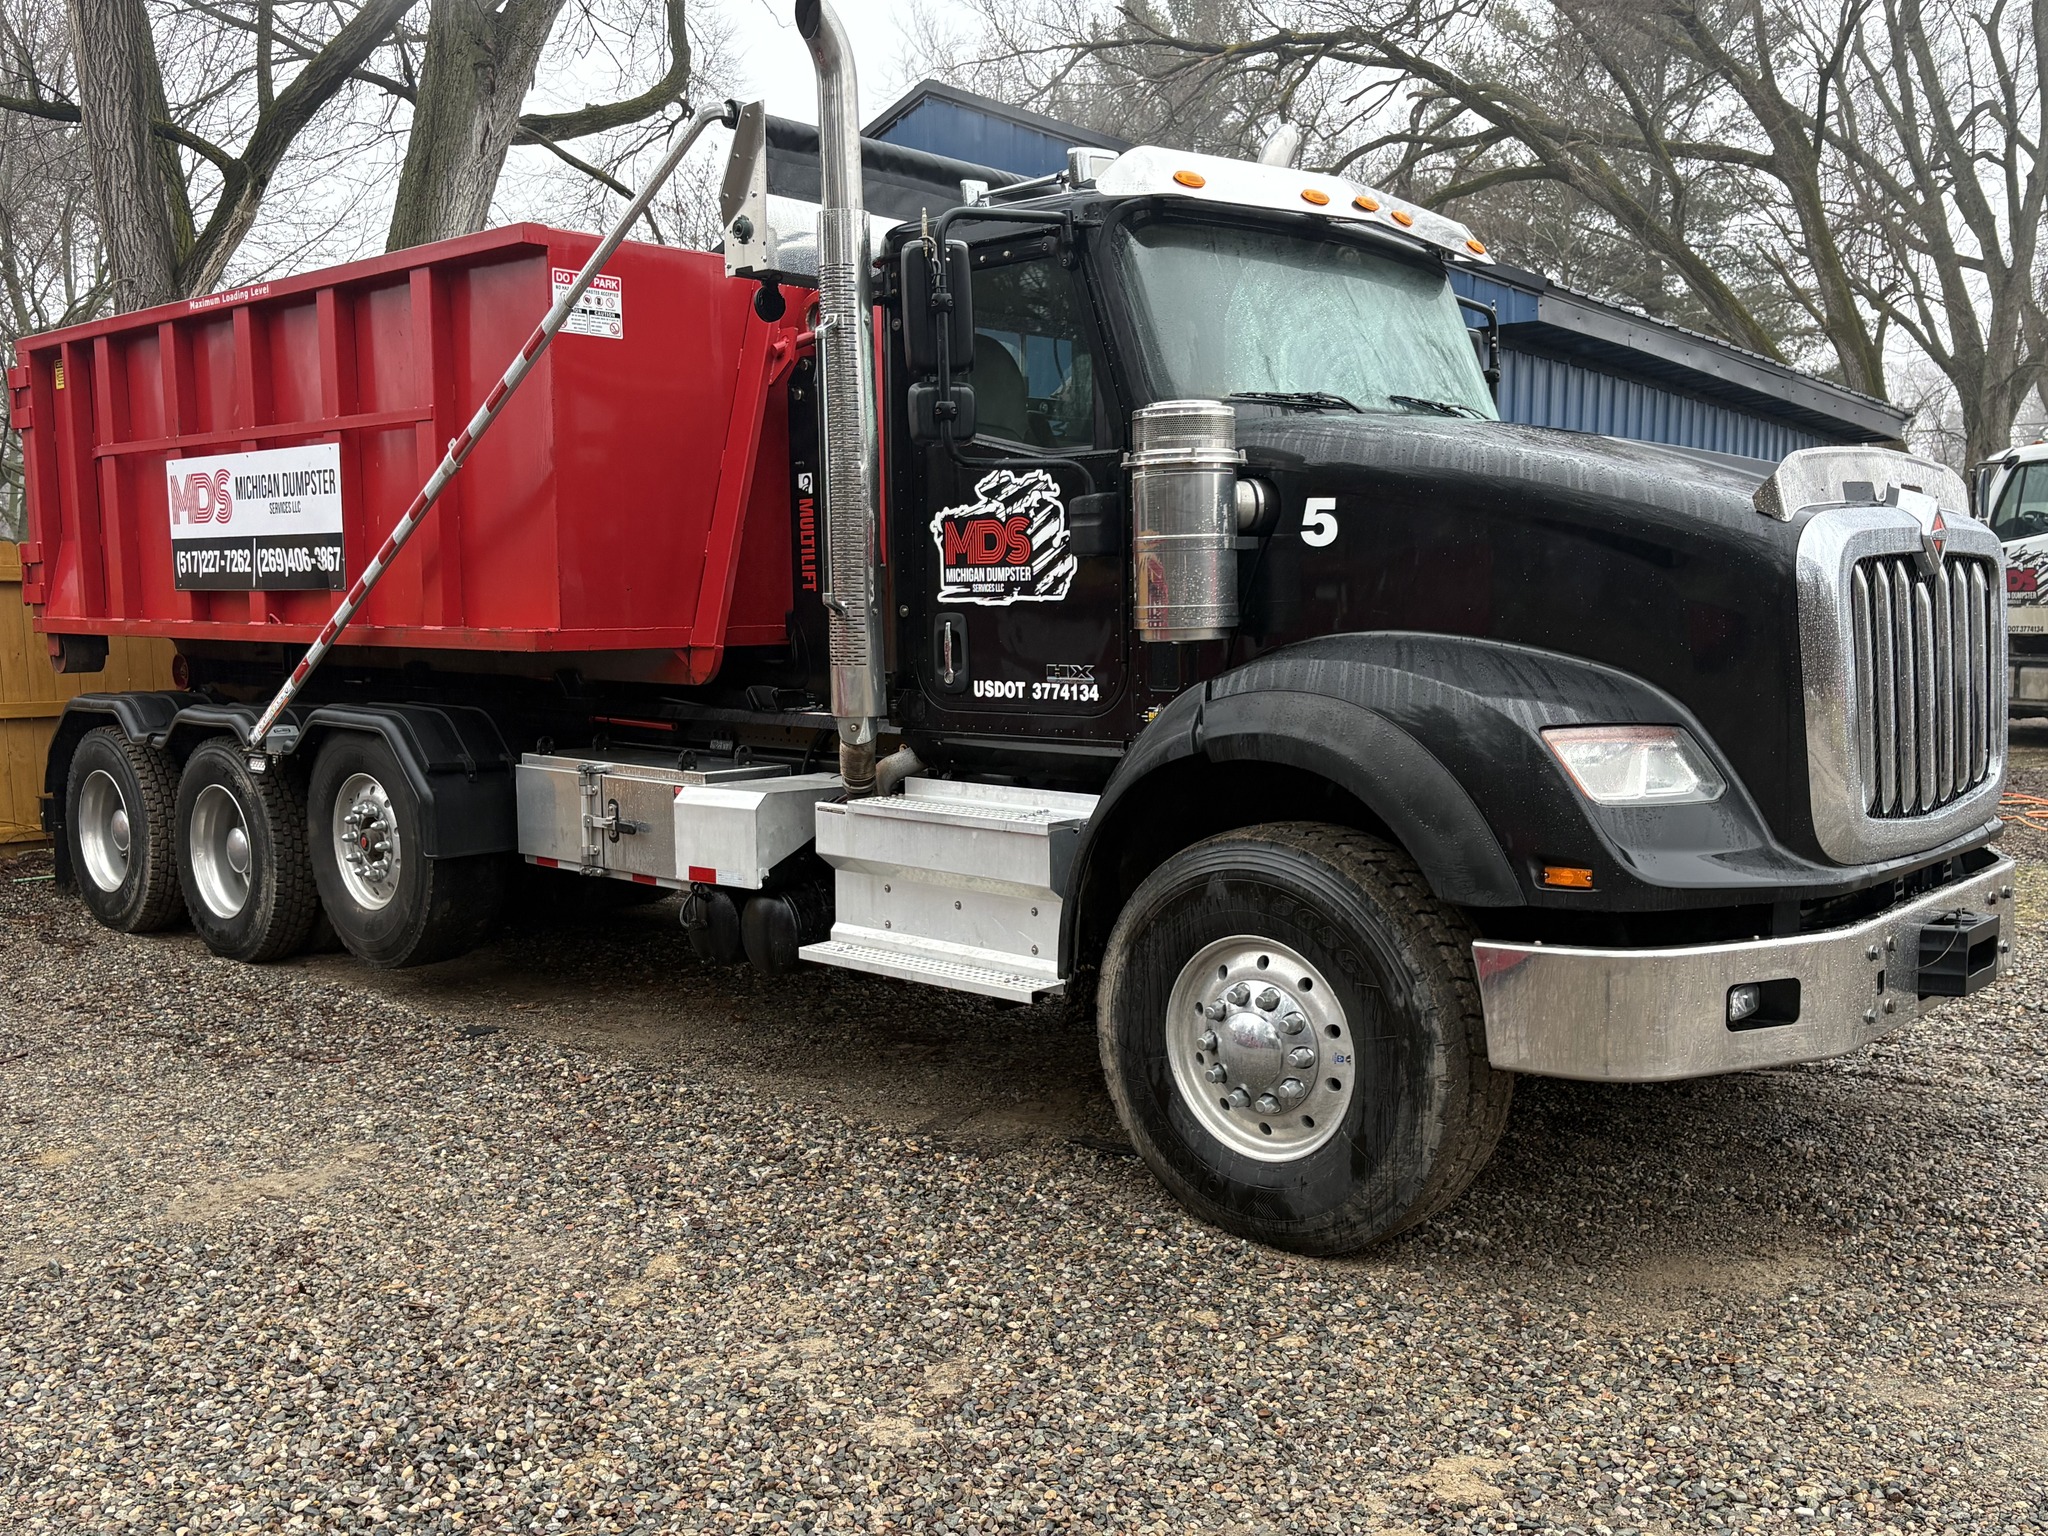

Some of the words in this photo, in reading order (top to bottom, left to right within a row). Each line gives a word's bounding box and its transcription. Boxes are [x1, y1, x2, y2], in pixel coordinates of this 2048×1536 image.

[556, 272, 570, 283] DO
[593, 277, 618, 290] PARK
[189, 297, 220, 310] Maximum
[222, 290, 249, 302] Loading
[250, 284, 269, 296] Level
[170, 468, 233, 525] MDS
[234, 473, 280, 501] MICHIGAN
[282, 468, 337, 498] DUMPSTER
[269, 501, 292, 515] SERVICES
[292, 500, 302, 514] LLC
[1300, 497, 1339, 548] 5
[799, 497, 817, 592] MULTILIFT
[944, 516, 1031, 566] MDS
[176, 549, 252, 579] (517)227-7262
[945, 568, 985, 583] MICHIGAN
[986, 566, 1032, 582] DUMPSTER
[972, 583, 996, 593] SERVICES
[995, 583, 1005, 593] LLC
[2006, 568, 2038, 592] DS
[1046, 664, 1095, 683] HX
[973, 680, 1026, 699] USDOT
[1031, 682, 1100, 701] 3774134
